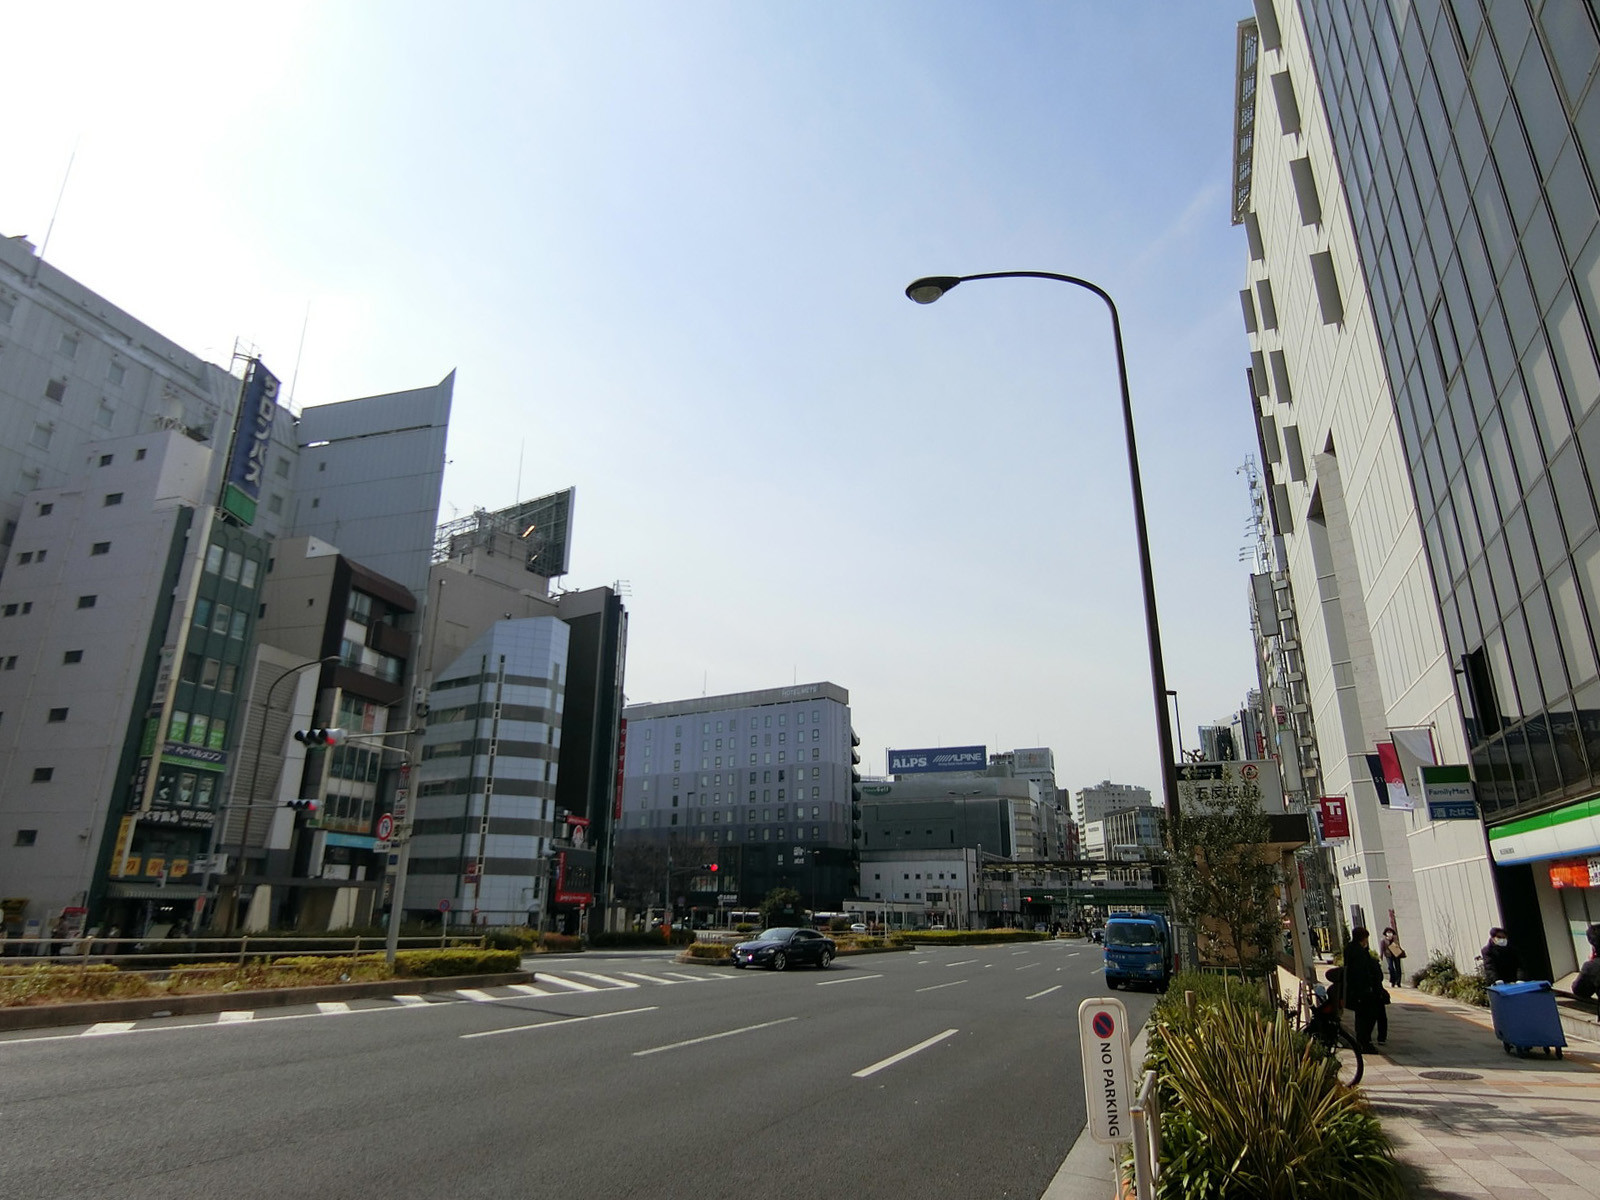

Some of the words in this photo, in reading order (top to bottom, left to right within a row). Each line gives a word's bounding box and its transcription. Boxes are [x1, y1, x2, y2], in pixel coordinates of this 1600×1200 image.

[892, 757, 928, 769] ALPS
[947, 752, 982, 763] ALPINE
[1428, 788, 1470, 797] FamilyMart
[1449, 808, 1475, 817] たばこ
[1100, 1042, 1112, 1064] NO
[1103, 1069, 1120, 1137] PARKING
